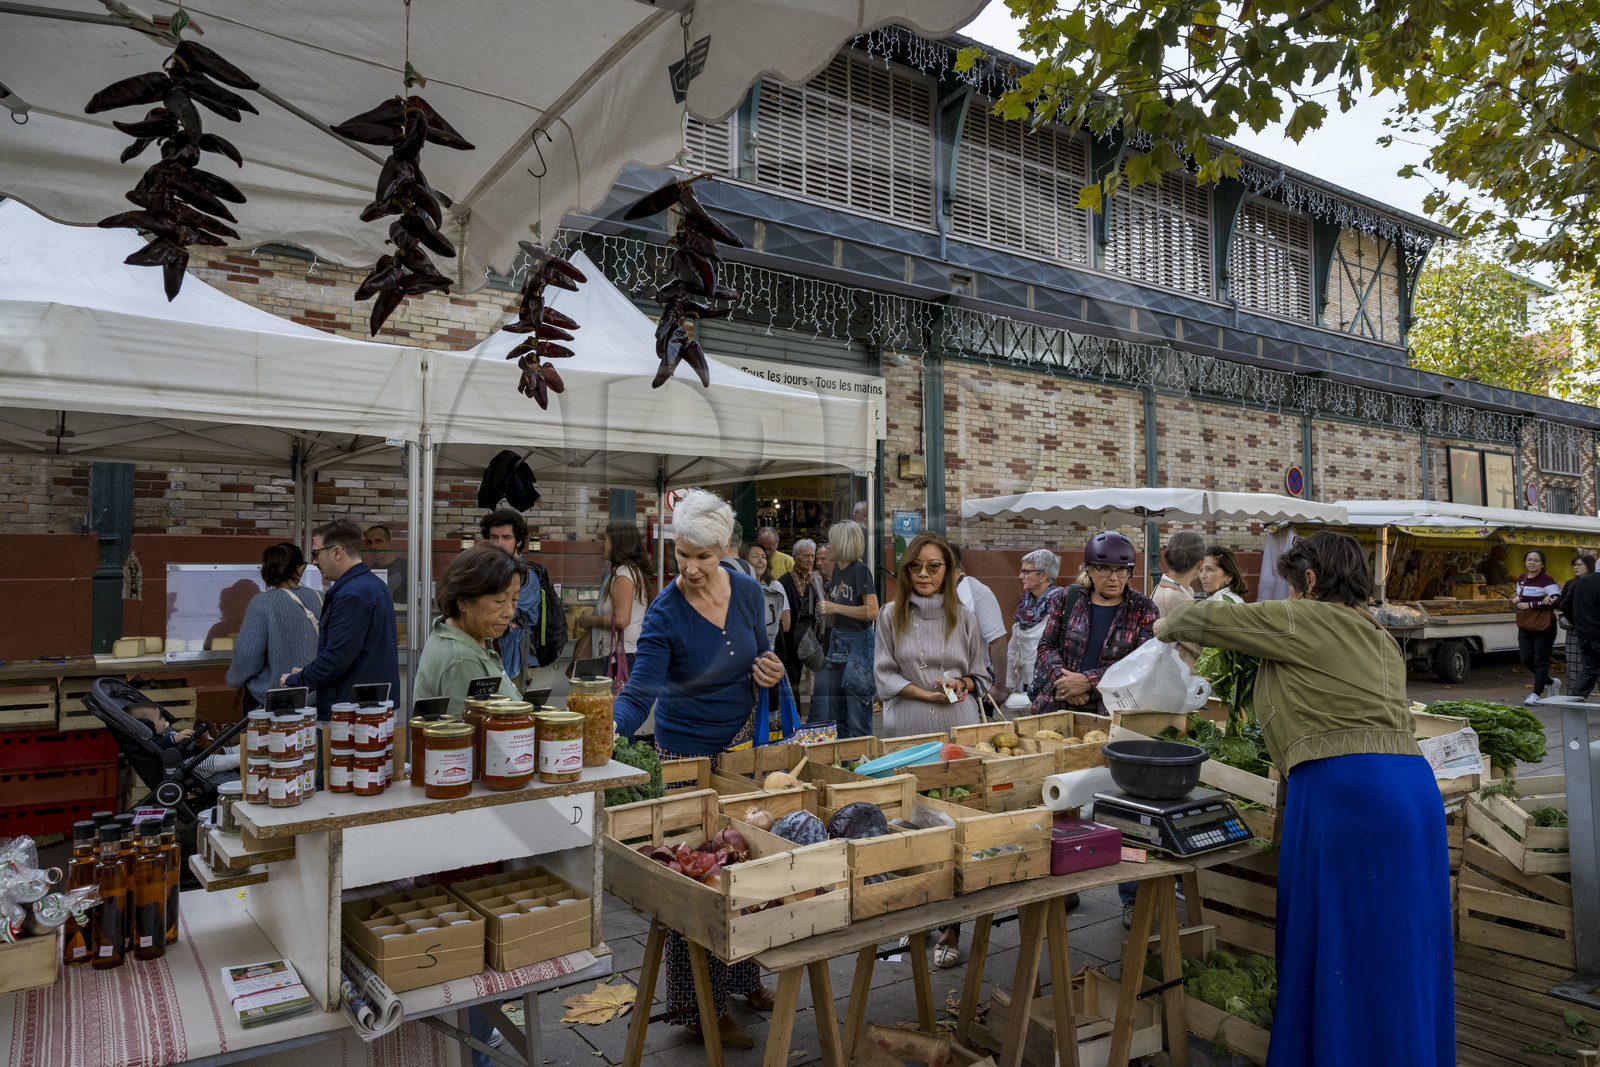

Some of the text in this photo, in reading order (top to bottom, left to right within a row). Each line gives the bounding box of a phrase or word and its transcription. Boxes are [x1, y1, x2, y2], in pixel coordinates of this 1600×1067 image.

[767, 370, 781, 383] les
[783, 372, 808, 386] jours
[815, 376, 837, 390] Tous
[839, 379, 852, 391] les
[854, 383, 883, 395] matins
[571, 806, 583, 825] D
